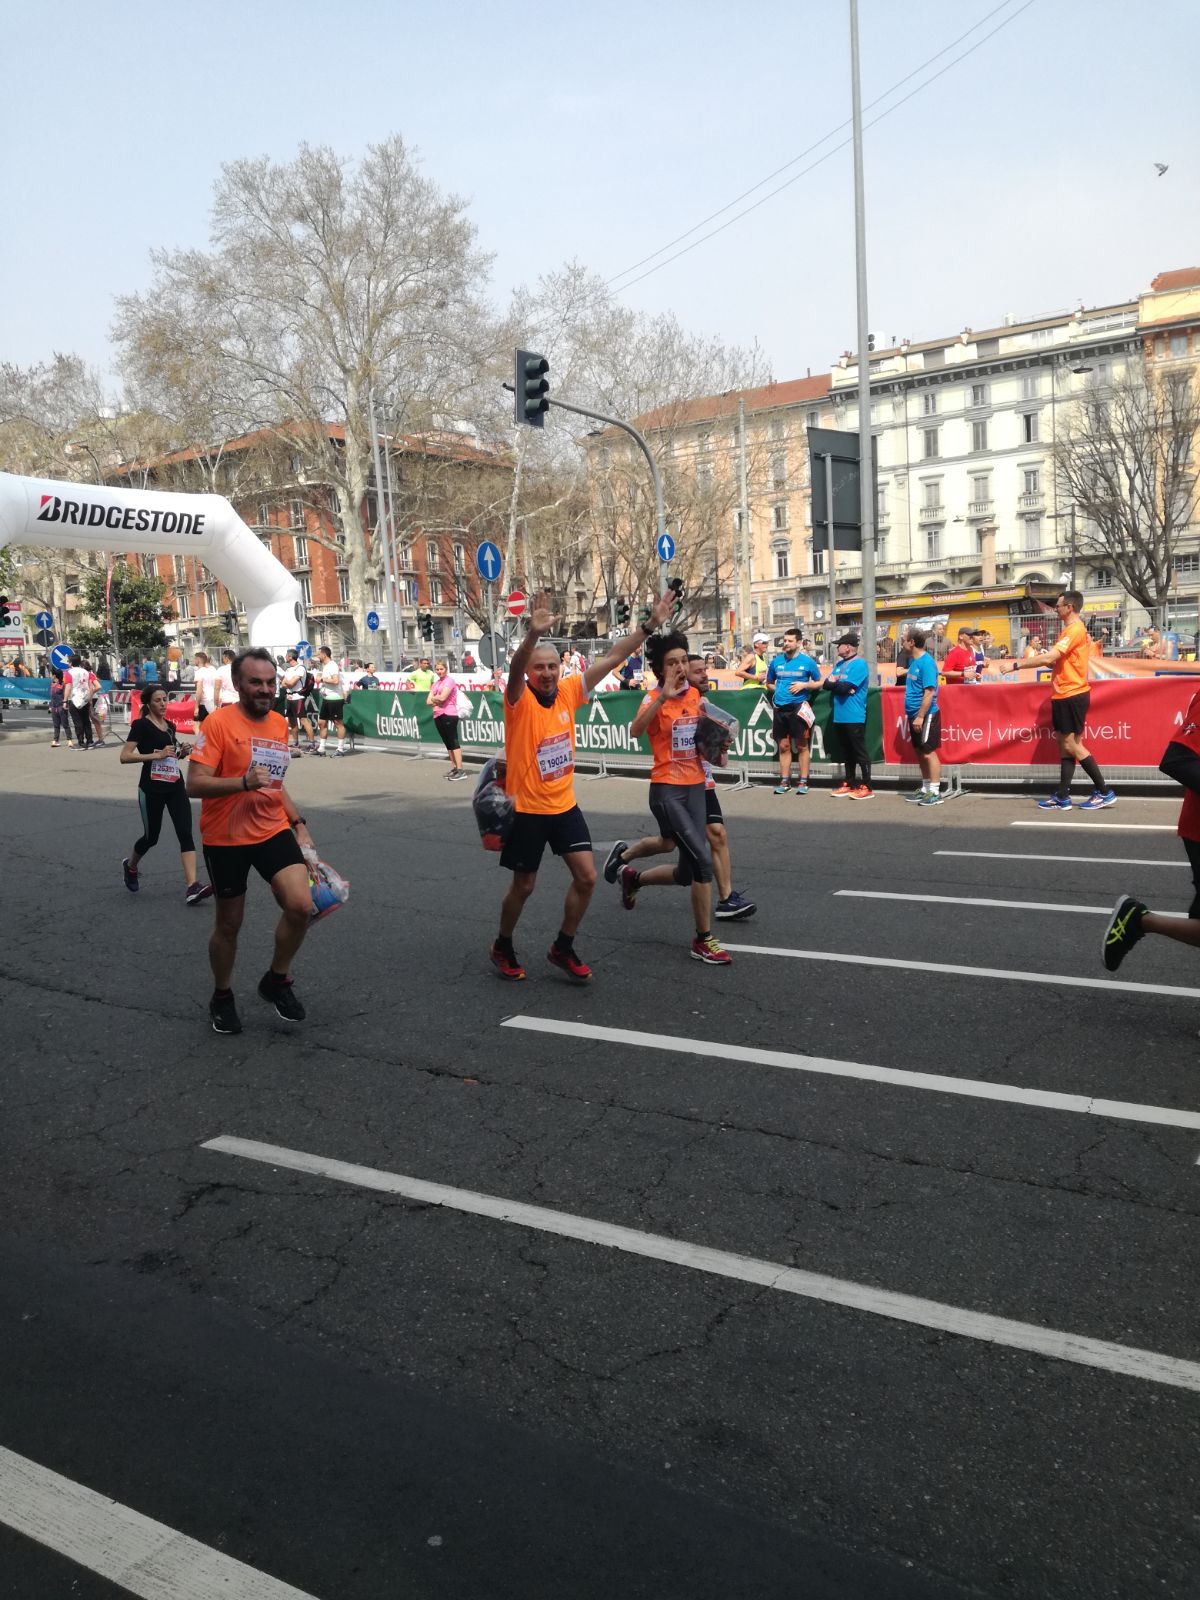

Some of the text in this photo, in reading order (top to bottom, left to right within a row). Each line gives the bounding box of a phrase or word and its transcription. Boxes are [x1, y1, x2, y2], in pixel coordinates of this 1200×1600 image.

[37, 495, 206, 535] BRIDGESTONE
[376, 713, 420, 739] LEVISSIMA
[460, 720, 505, 743] LEVISSIM
[574, 721, 640, 752] EVISSIMA
[940, 723, 983, 742] ctive
[547, 753, 567, 769] 1902A
